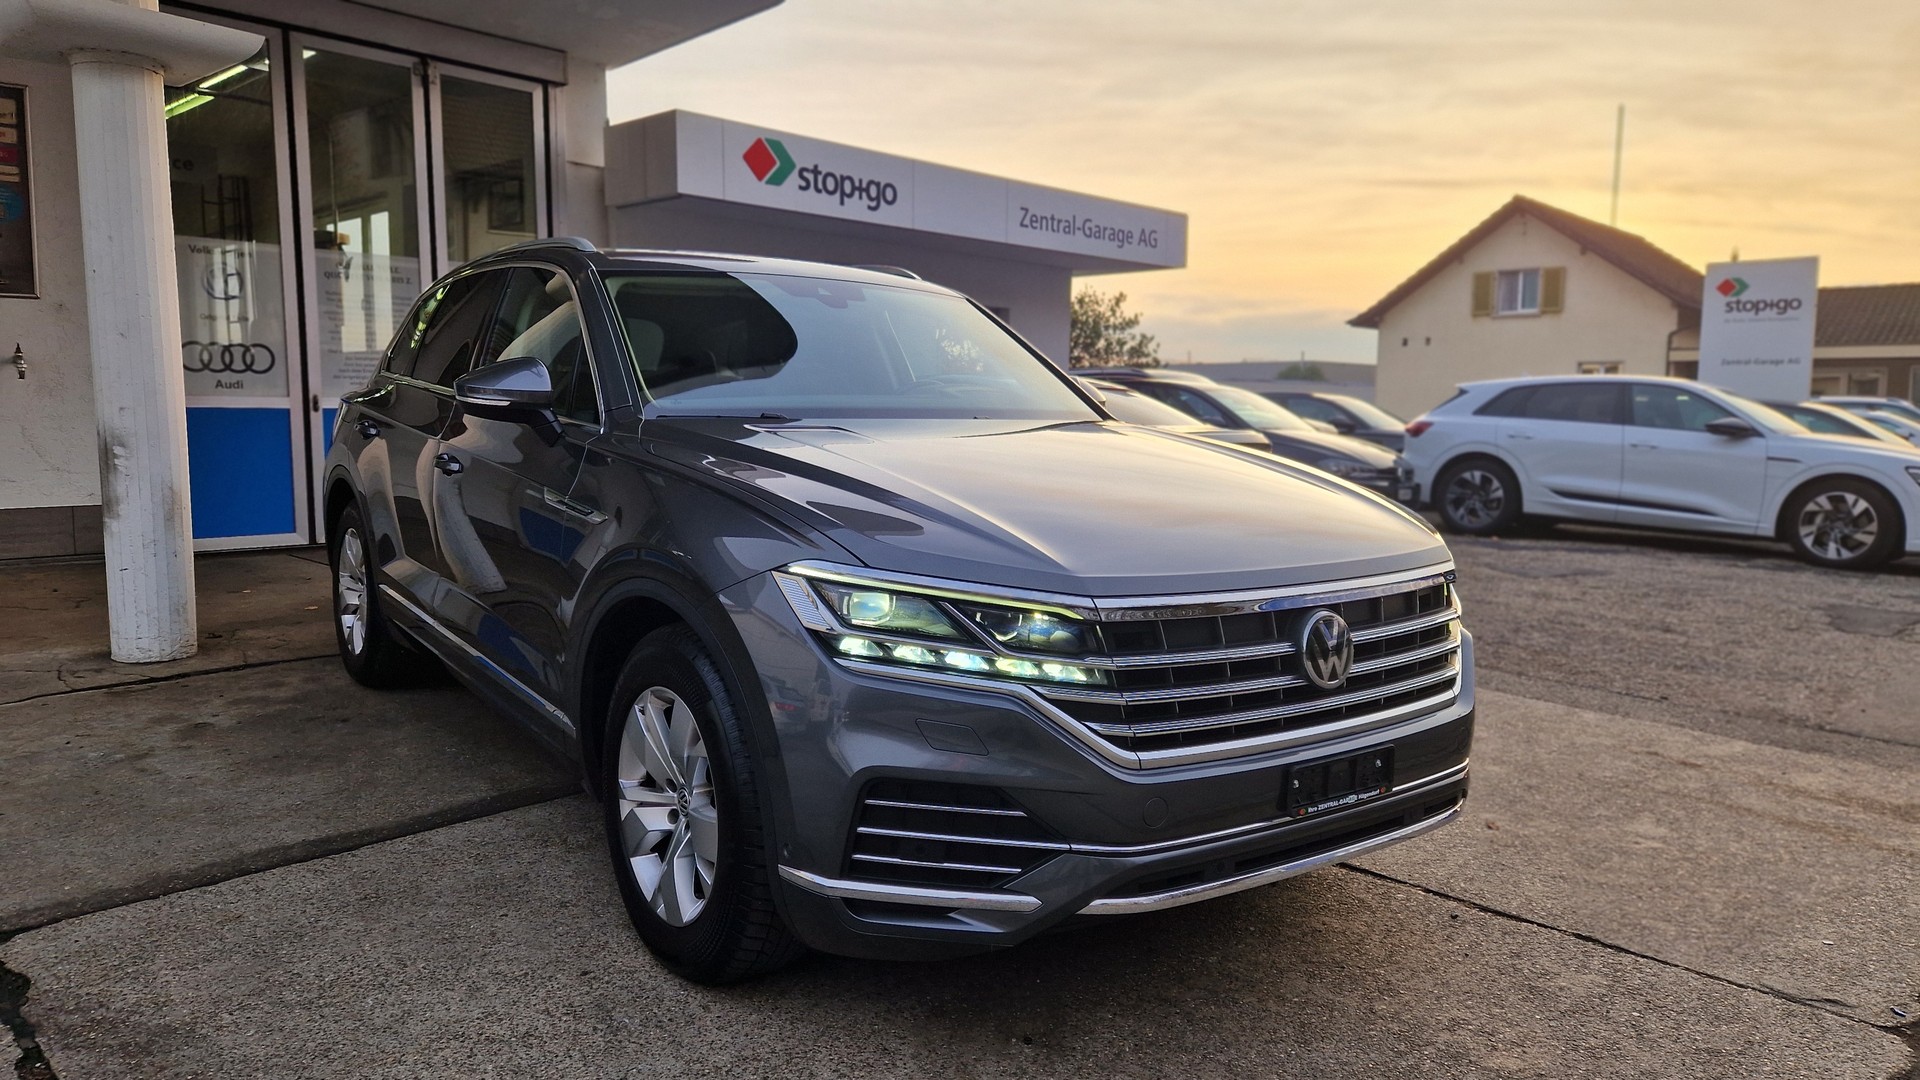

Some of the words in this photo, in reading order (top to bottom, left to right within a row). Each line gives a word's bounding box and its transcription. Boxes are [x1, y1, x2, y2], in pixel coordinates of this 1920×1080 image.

[798, 164, 897, 211] stop+go
[1019, 206, 1133, 249] Zentral-Garage
[1137, 228, 1158, 248] AG
[1724, 298, 1802, 316] stop+go
[215, 379, 244, 389] Audi
